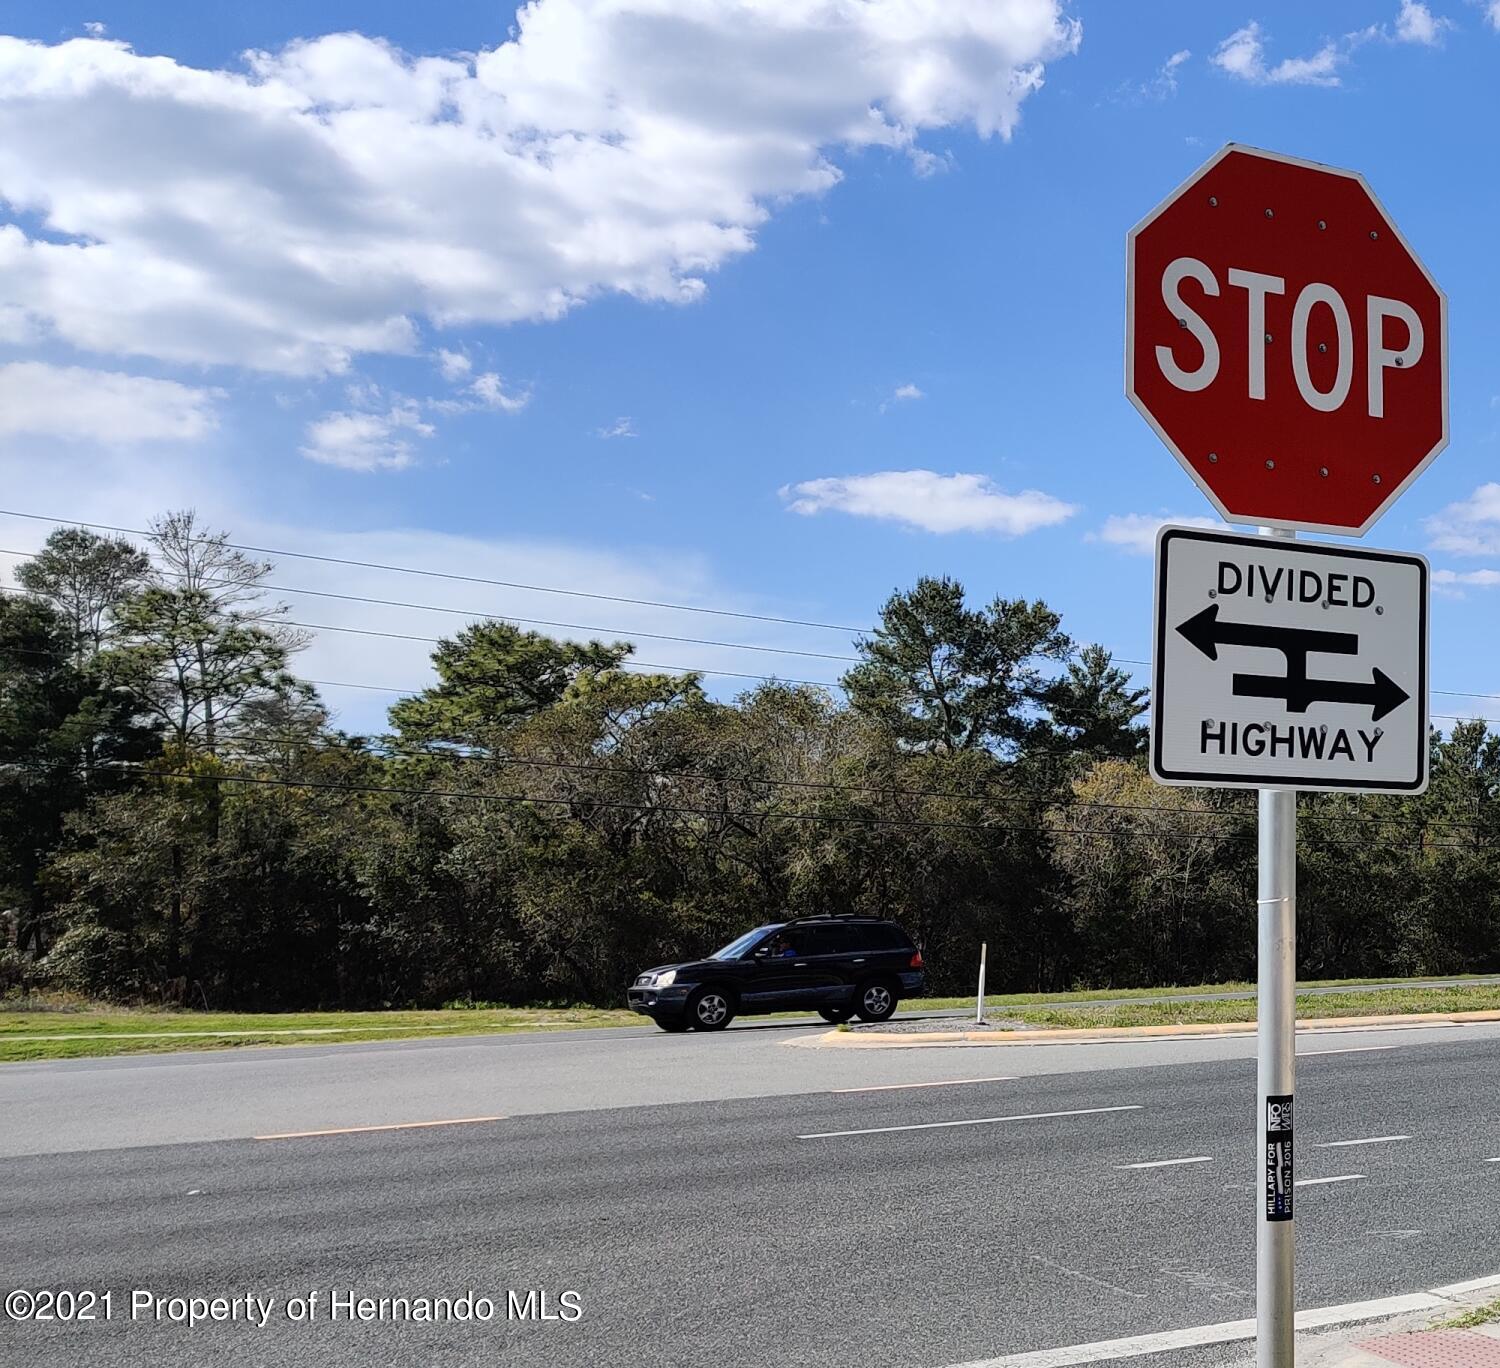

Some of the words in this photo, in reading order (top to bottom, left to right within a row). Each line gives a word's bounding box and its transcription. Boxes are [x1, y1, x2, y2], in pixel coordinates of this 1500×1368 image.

[1155, 256, 1425, 419] STOP
[1217, 561, 1376, 609] DIVIDED
[1201, 721, 1384, 763] HIGHWAY
[1271, 1103, 1281, 1131] INFO
[1282, 1102, 1291, 1131] WARS
